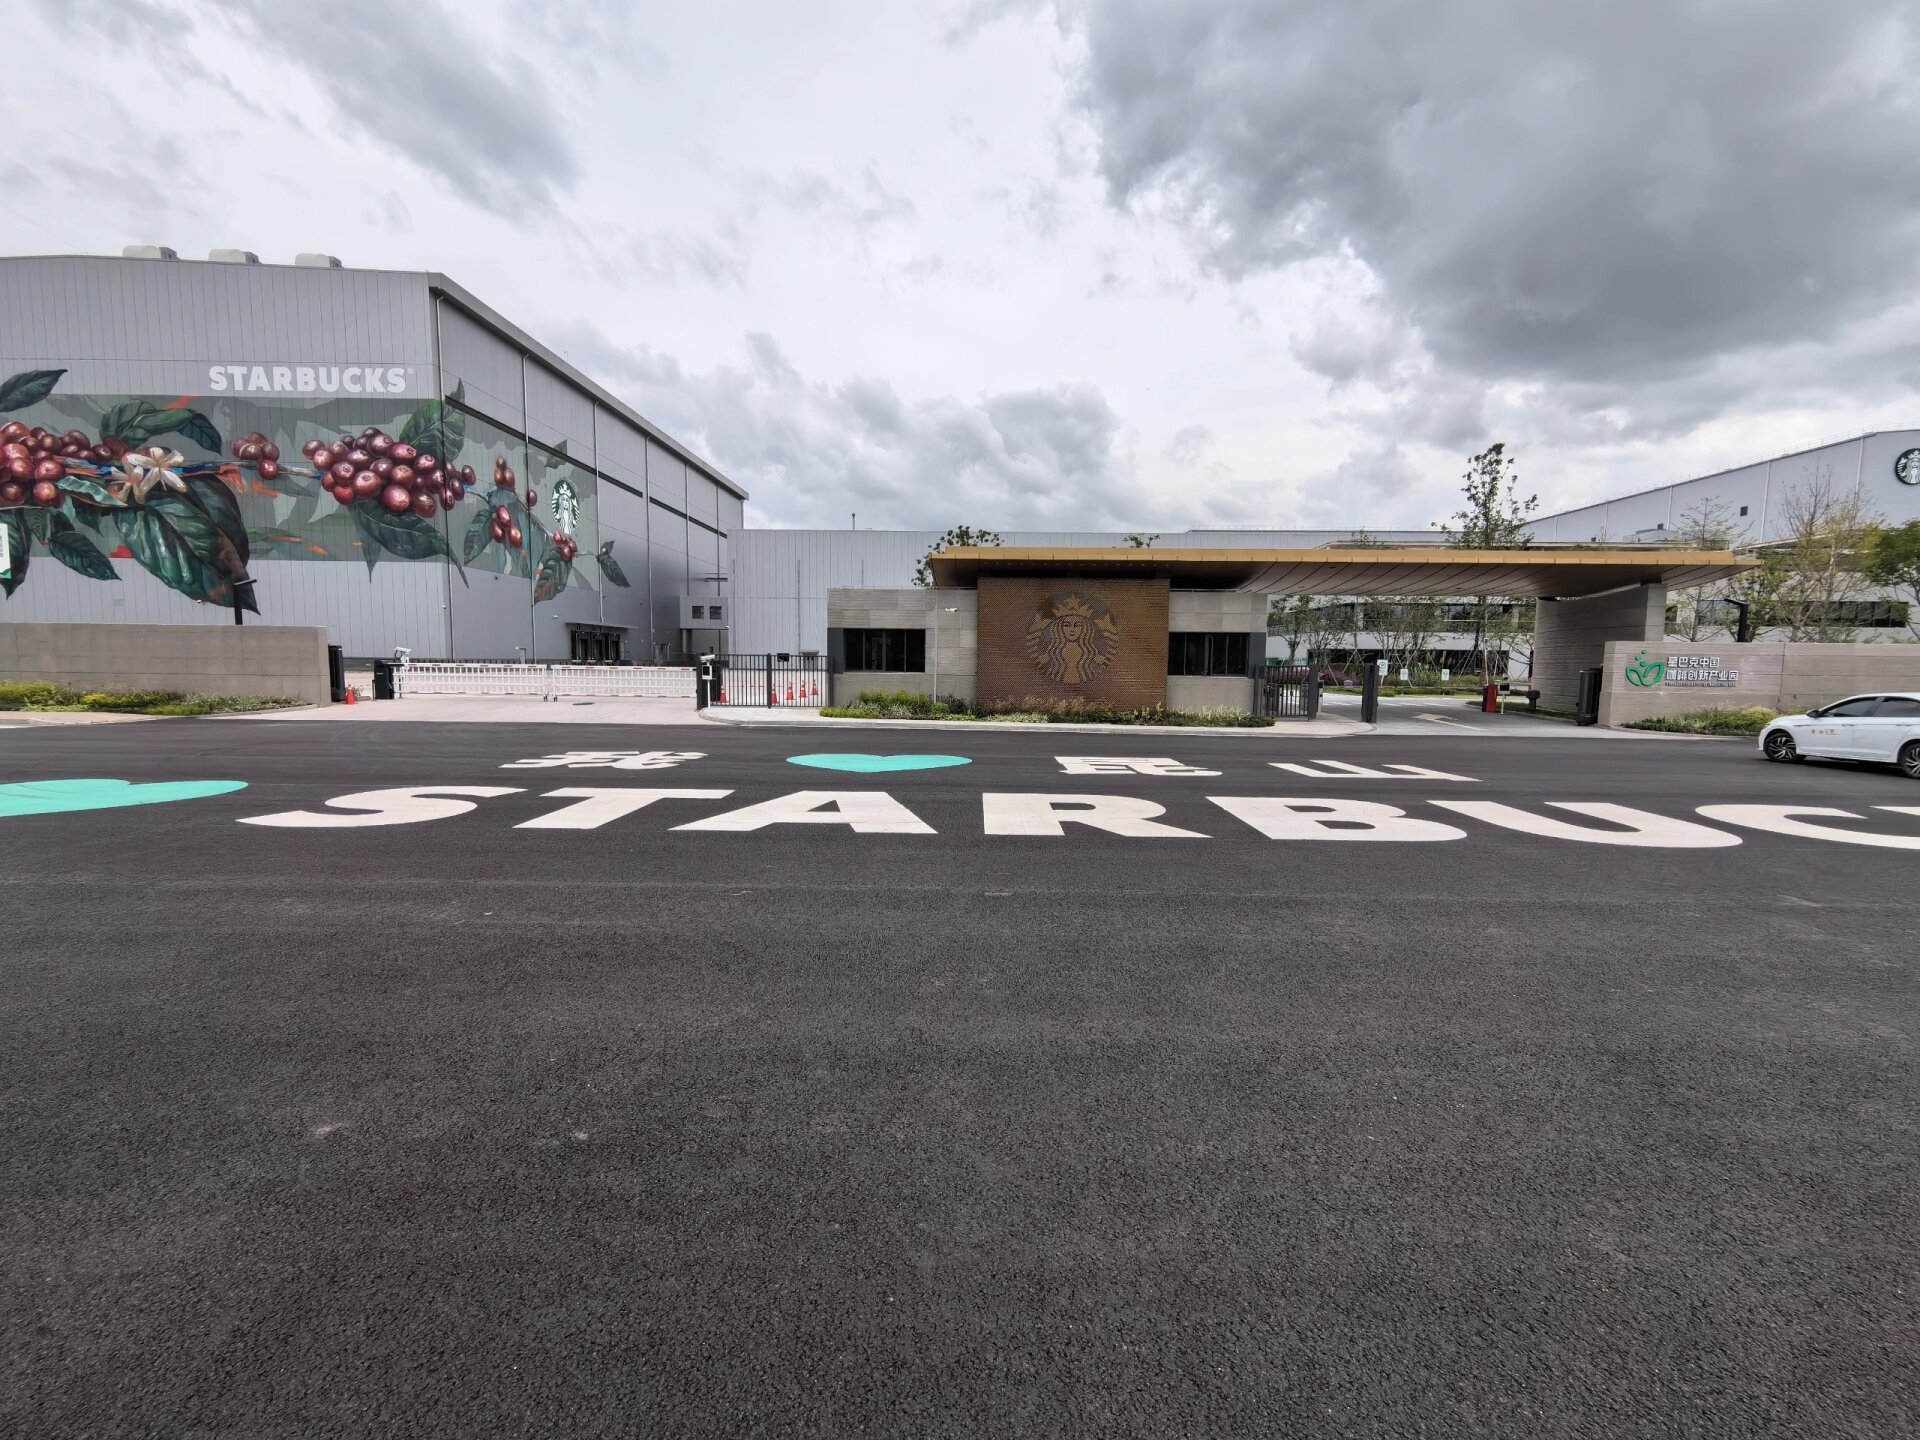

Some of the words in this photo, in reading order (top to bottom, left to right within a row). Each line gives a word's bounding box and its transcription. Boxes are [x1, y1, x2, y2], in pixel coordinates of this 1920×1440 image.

[208, 365, 406, 393] STARBUCKS
[1667, 656, 1720, 668] 星巴克中国
[1666, 669, 1739, 681] 咖啡创新产业园
[498, 751, 709, 770] 我
[236, 785, 1920, 850] STARBUC
